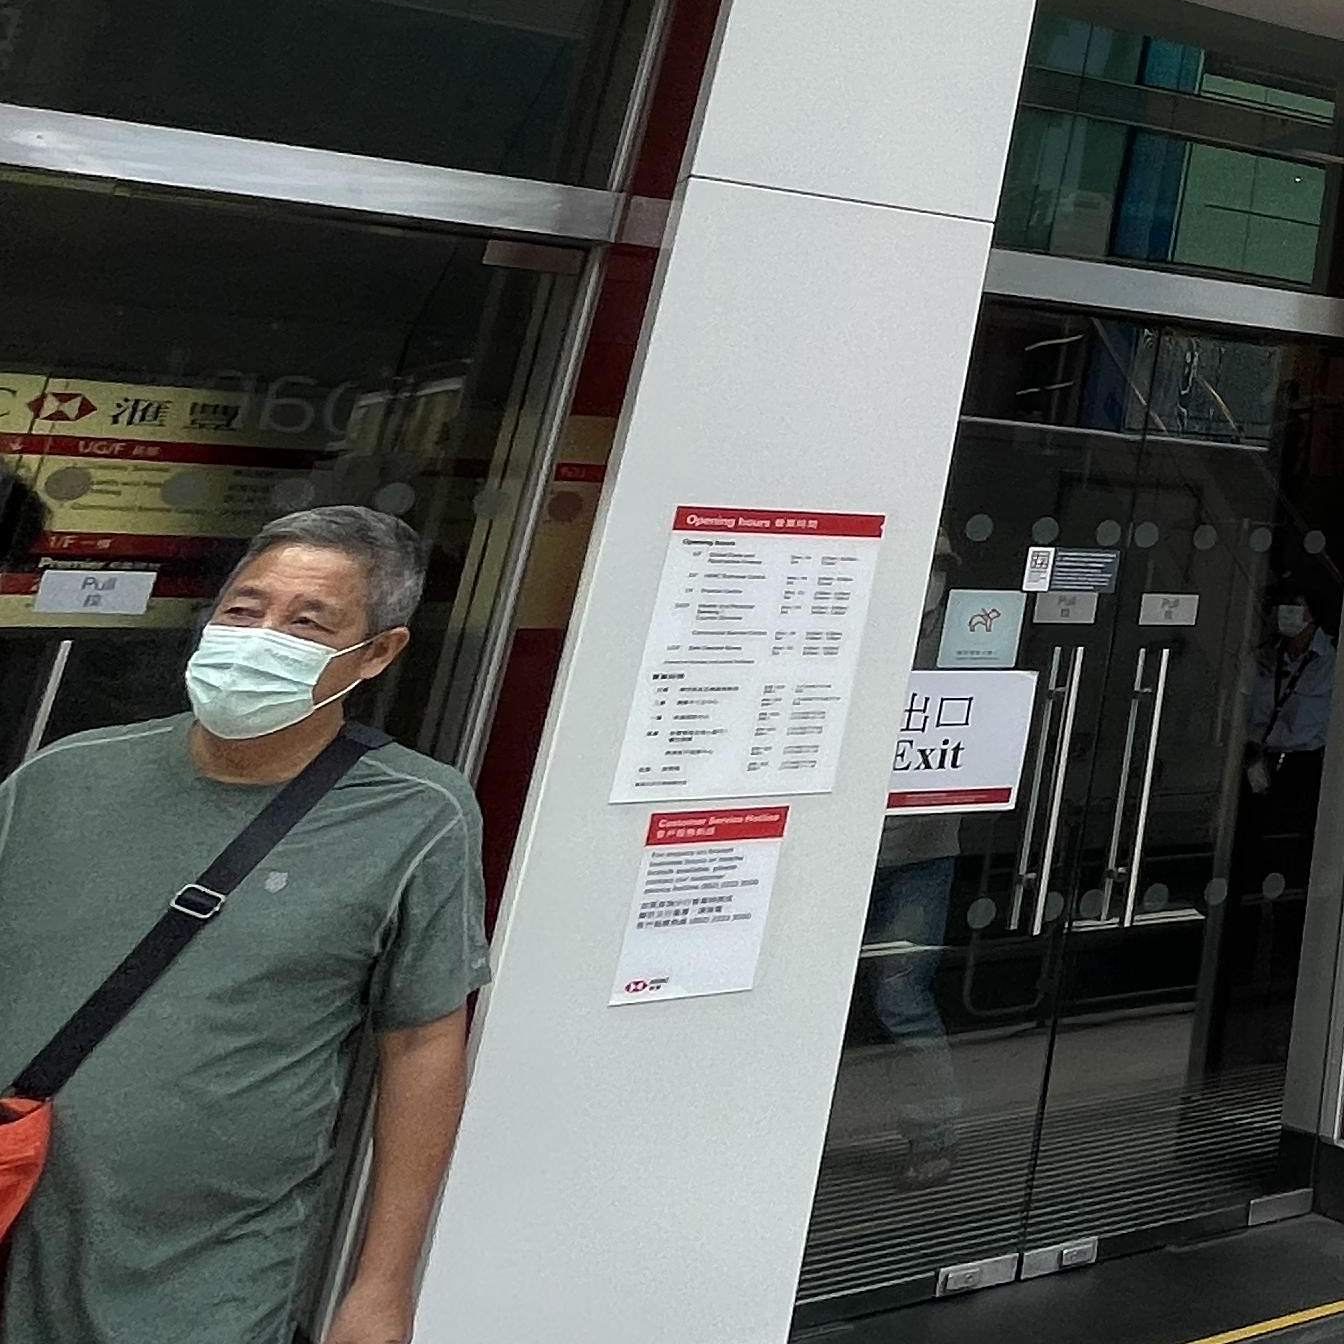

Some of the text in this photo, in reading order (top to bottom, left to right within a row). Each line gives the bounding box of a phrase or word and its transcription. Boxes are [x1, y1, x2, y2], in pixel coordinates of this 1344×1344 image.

[686, 514, 771, 527] Opening hours
[81, 576, 118, 591] Pull
[900, 693, 974, 733] 出口
[892, 739, 965, 771] Exit
